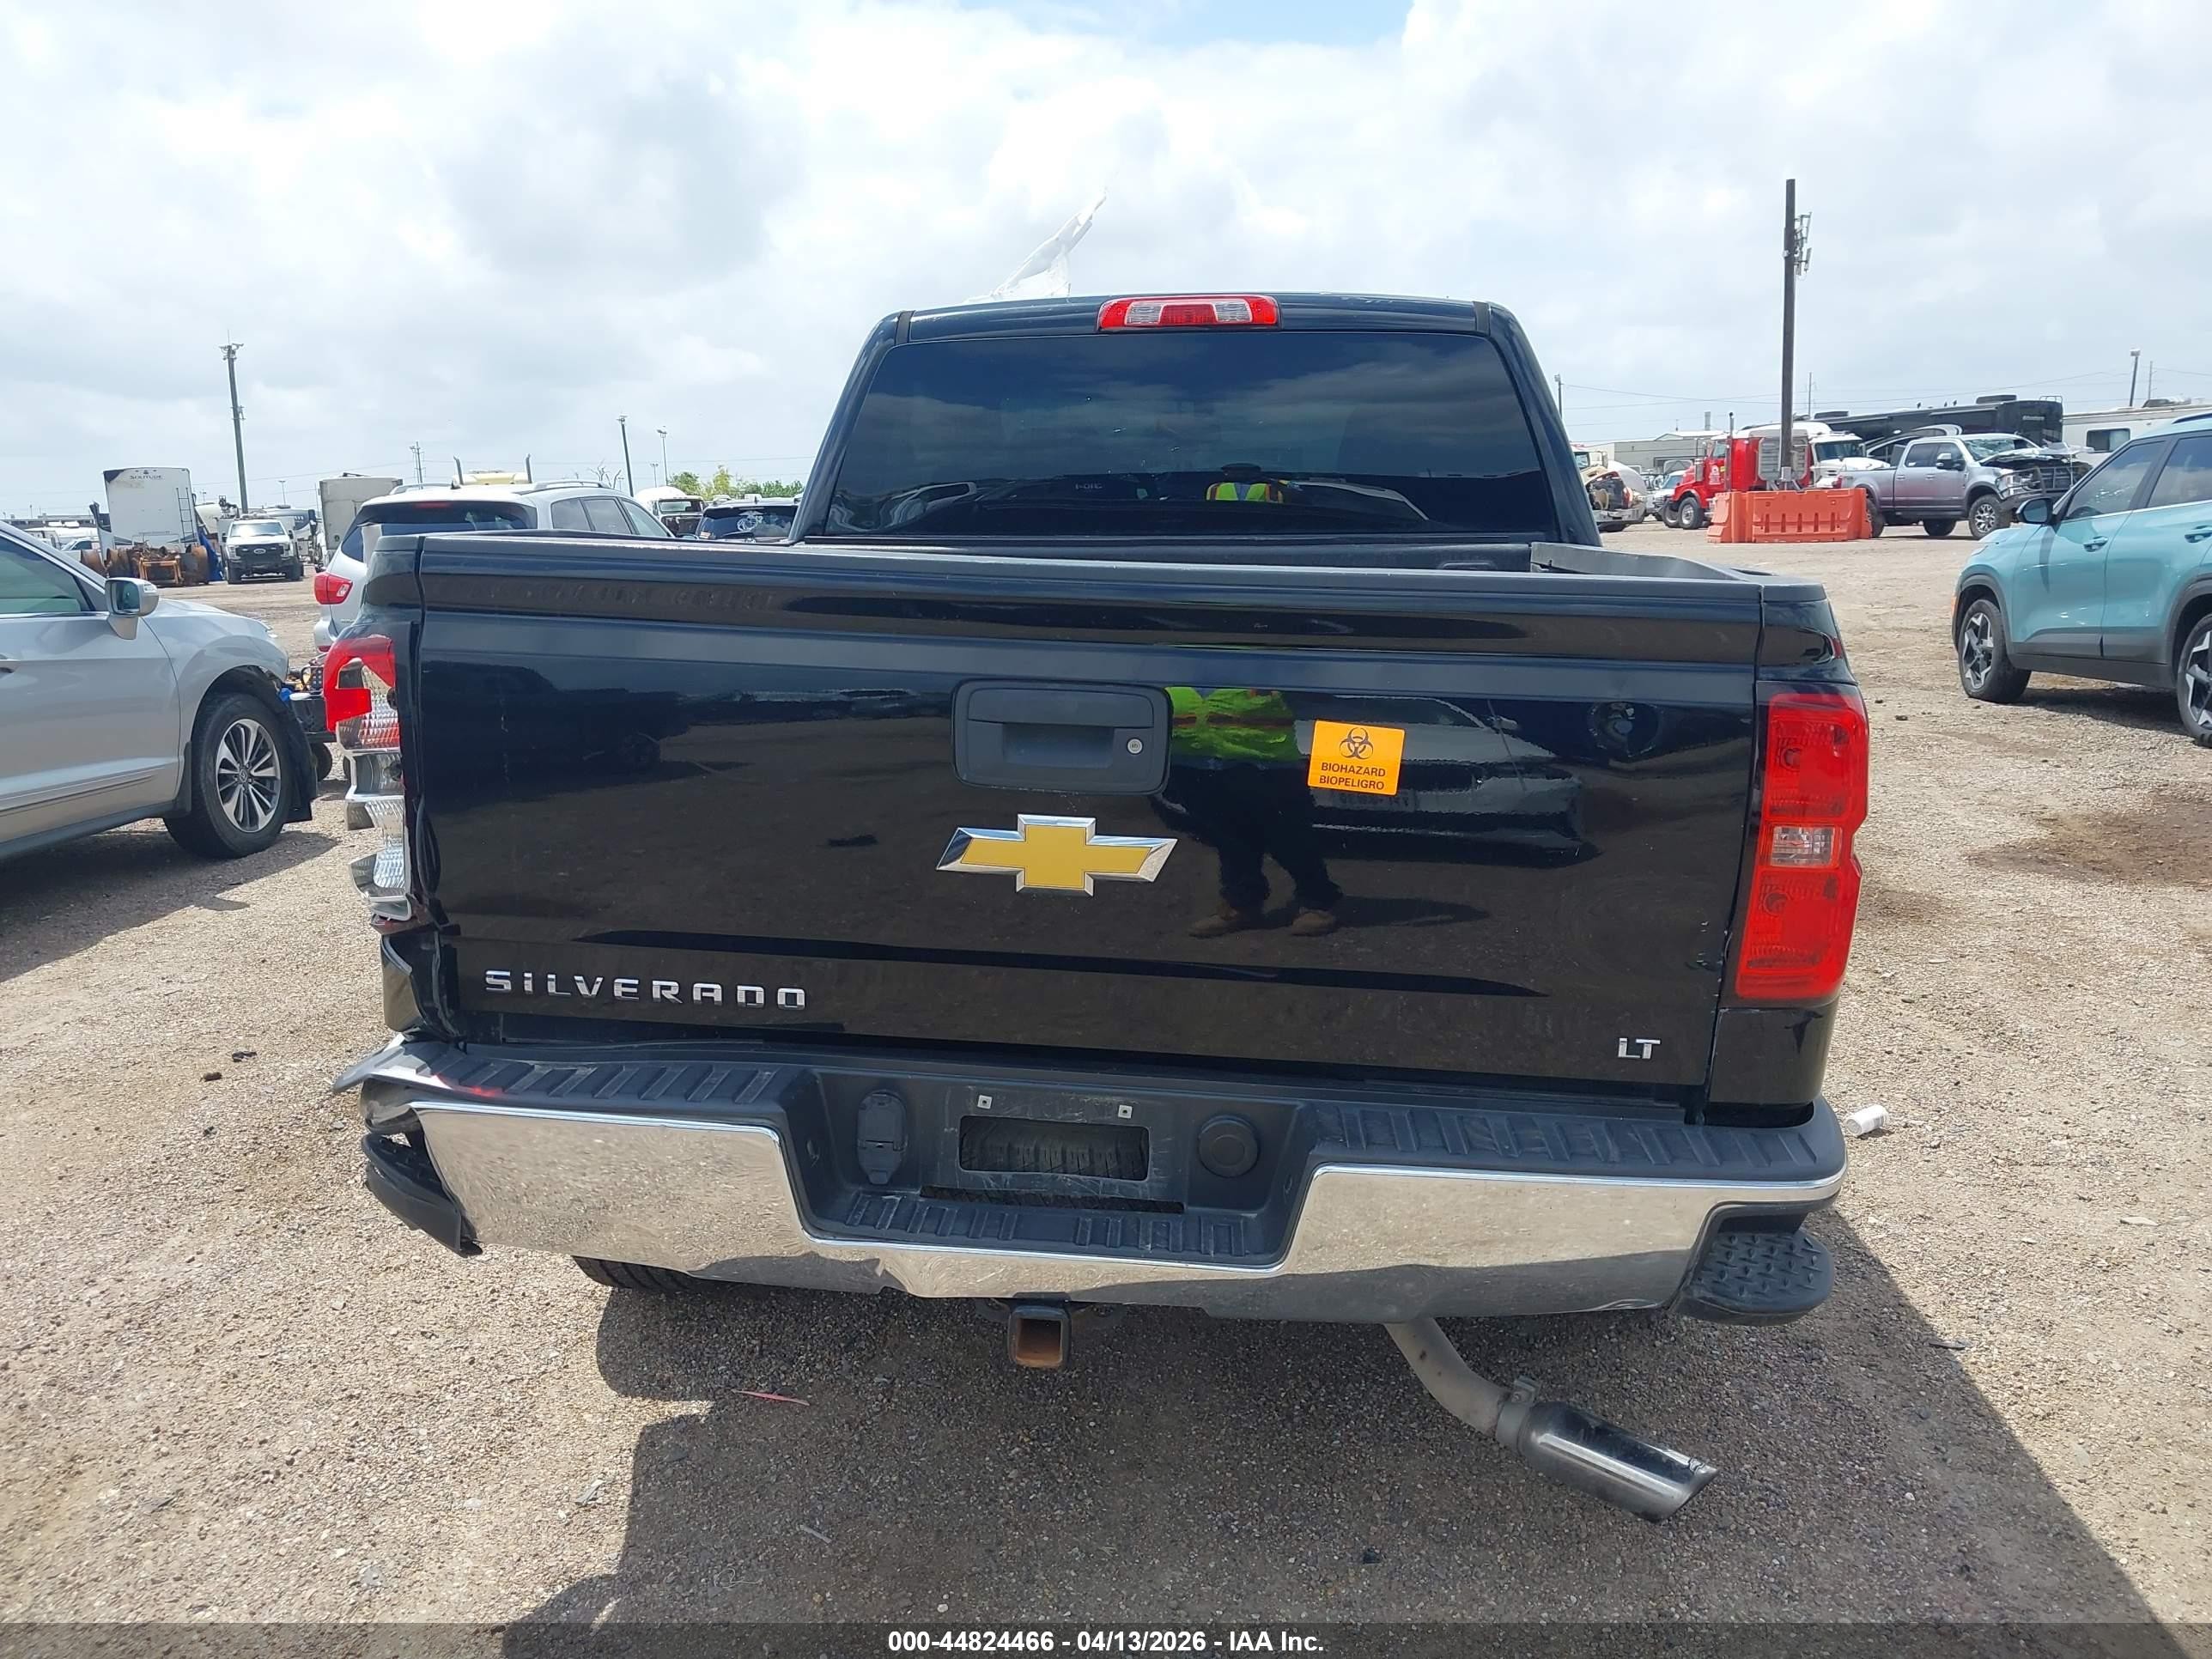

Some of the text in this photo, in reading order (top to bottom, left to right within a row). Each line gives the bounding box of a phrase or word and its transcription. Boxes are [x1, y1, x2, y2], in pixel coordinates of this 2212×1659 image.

[1321, 762, 1386, 777] BIOHAZARD
[1319, 775, 1385, 790] BIOPELIGRO
[485, 969, 806, 1009] SILVERADO
[1618, 1037, 1661, 1060] LT
